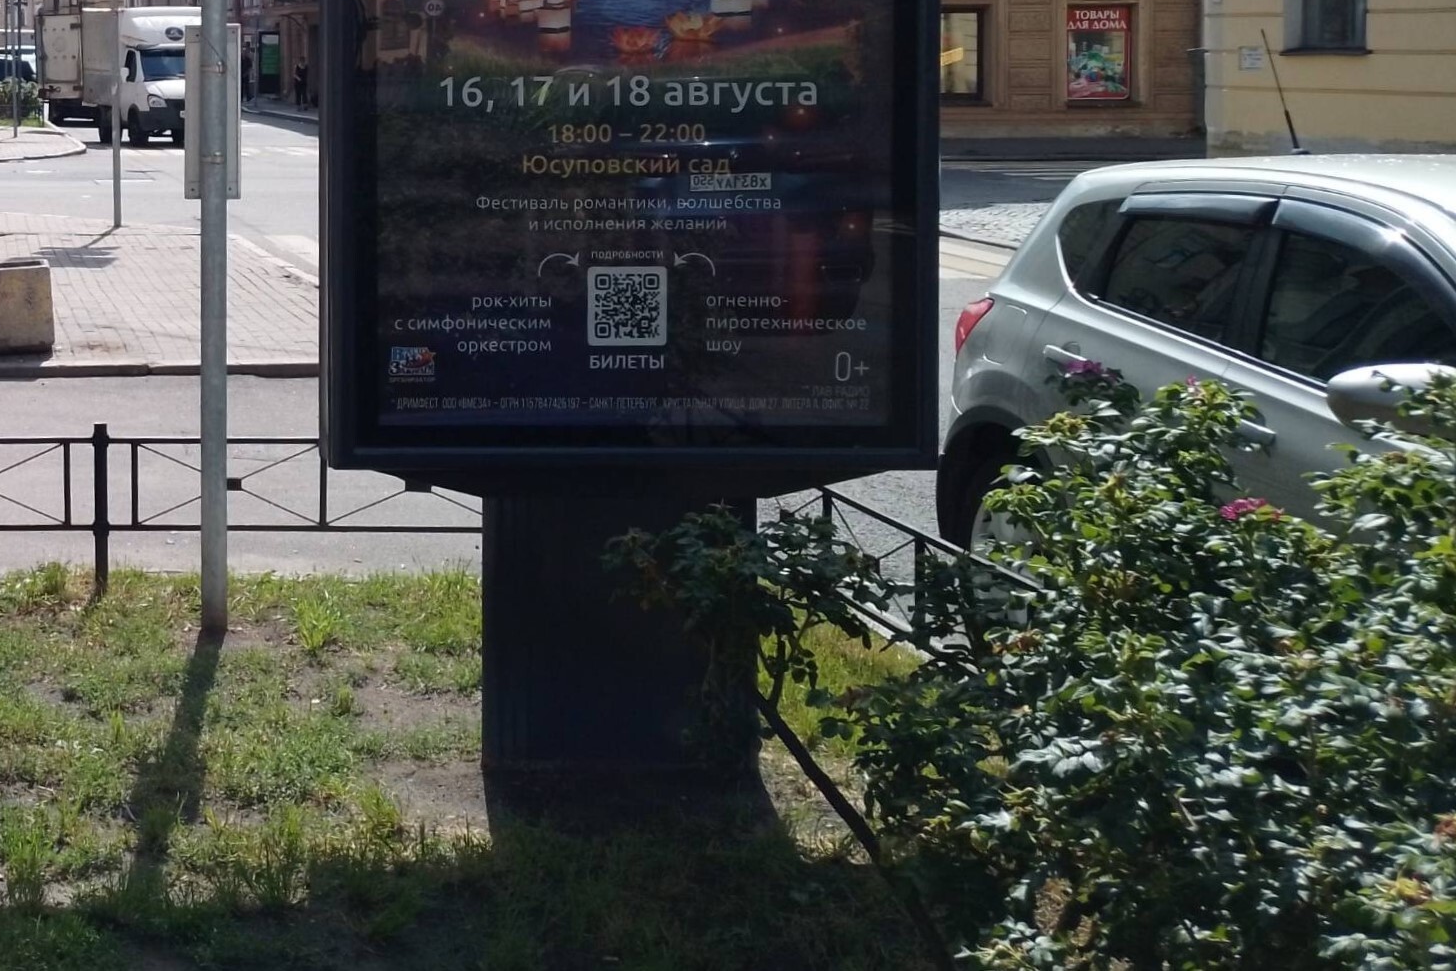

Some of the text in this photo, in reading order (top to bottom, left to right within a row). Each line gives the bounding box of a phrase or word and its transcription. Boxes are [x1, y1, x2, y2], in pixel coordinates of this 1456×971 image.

[1074, 9, 1120, 20] ТОВАРЫ
[1066, 20, 1127, 30] ДЛЯ ДОМА
[440, 75, 818, 114] 16, 17 и 18 августа
[548, 123, 612, 143] 18:00
[639, 122, 706, 142] 22:00
[521, 152, 731, 179] Юсуповский сад
[475, 195, 781, 214] Фестиваль романтики, волшебства
[529, 216, 727, 231] и исполнения желаний
[591, 250, 664, 261] ПОДРОБНОСТИ
[472, 296, 552, 311] рок-хиты
[705, 295, 789, 308] огненно-
[394, 315, 552, 334] с симфоническим
[705, 317, 867, 333] пиротехническое
[457, 340, 552, 354] оркестром
[705, 340, 742, 355] шоу
[589, 354, 665, 370] БИЛЕТЫ
[834, 351, 870, 382] 0+
